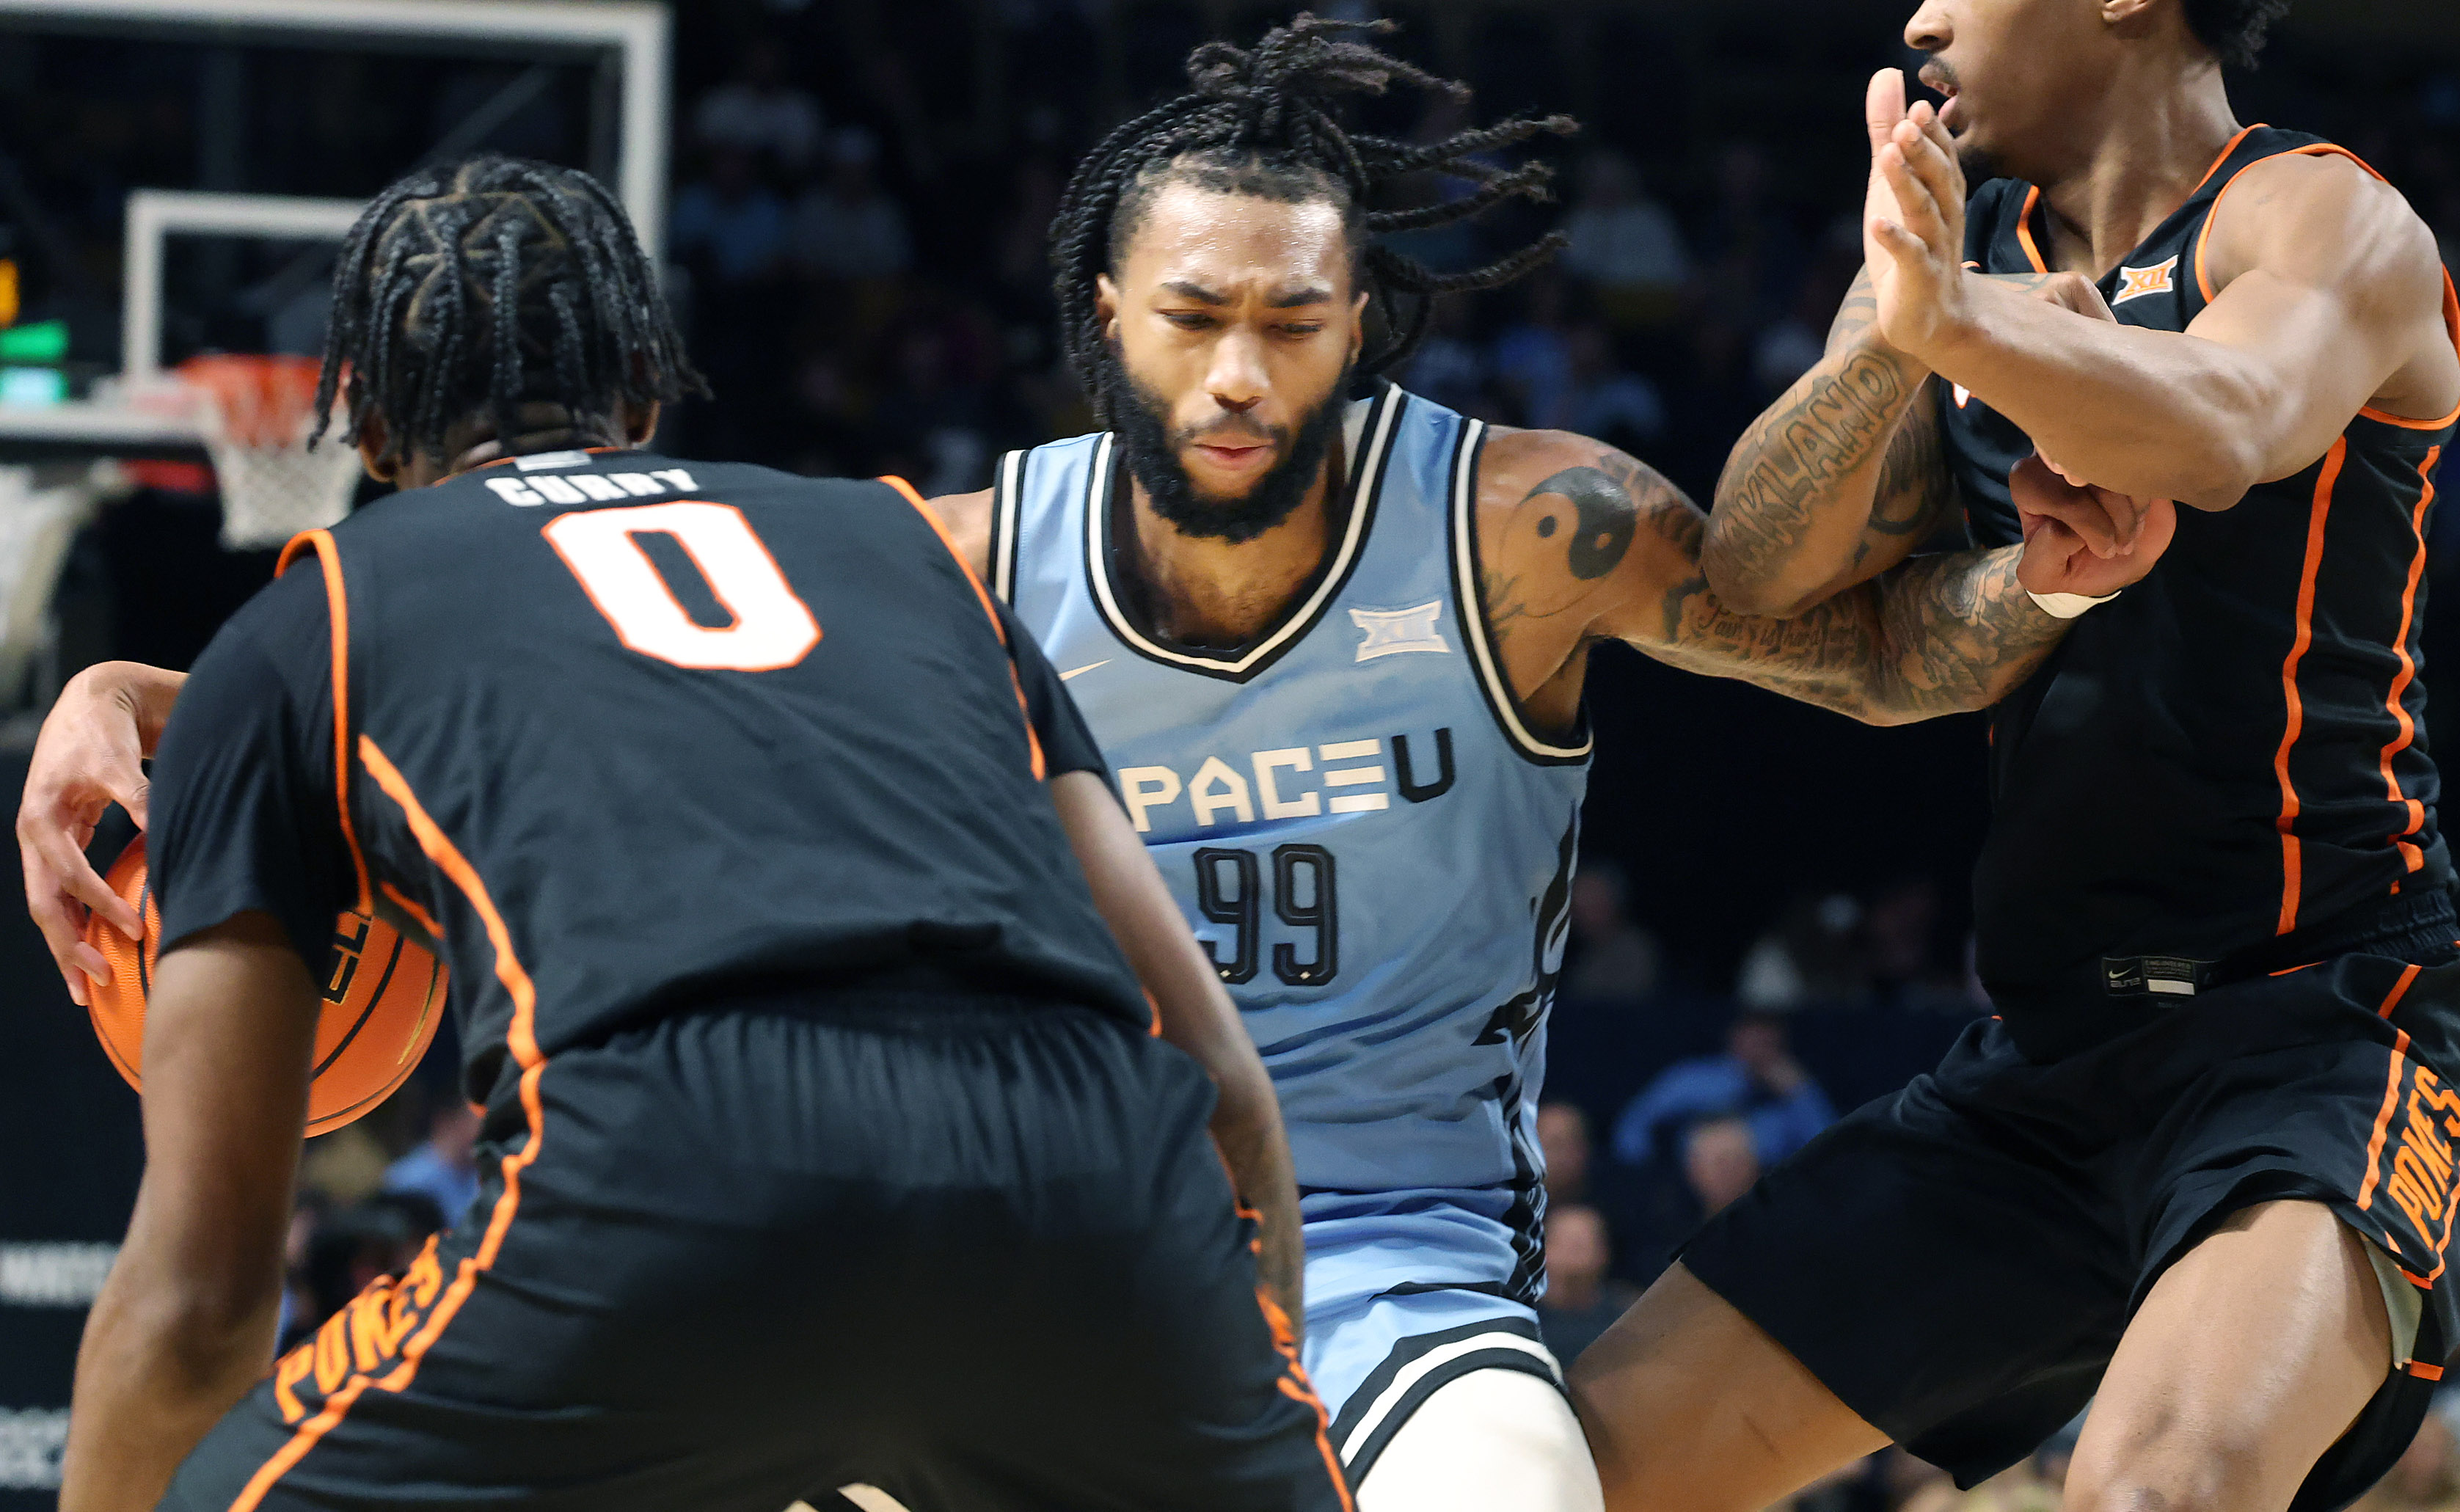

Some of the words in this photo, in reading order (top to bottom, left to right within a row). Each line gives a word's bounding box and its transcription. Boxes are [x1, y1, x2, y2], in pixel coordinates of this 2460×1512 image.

[484, 468, 699, 507] CURRY
[541, 500, 823, 673] 0
[1118, 727, 1456, 833] PACEU
[1193, 843, 1339, 987] 99
[2387, 1065, 2460, 1252] POKES
[274, 1232, 443, 1417] POKES
